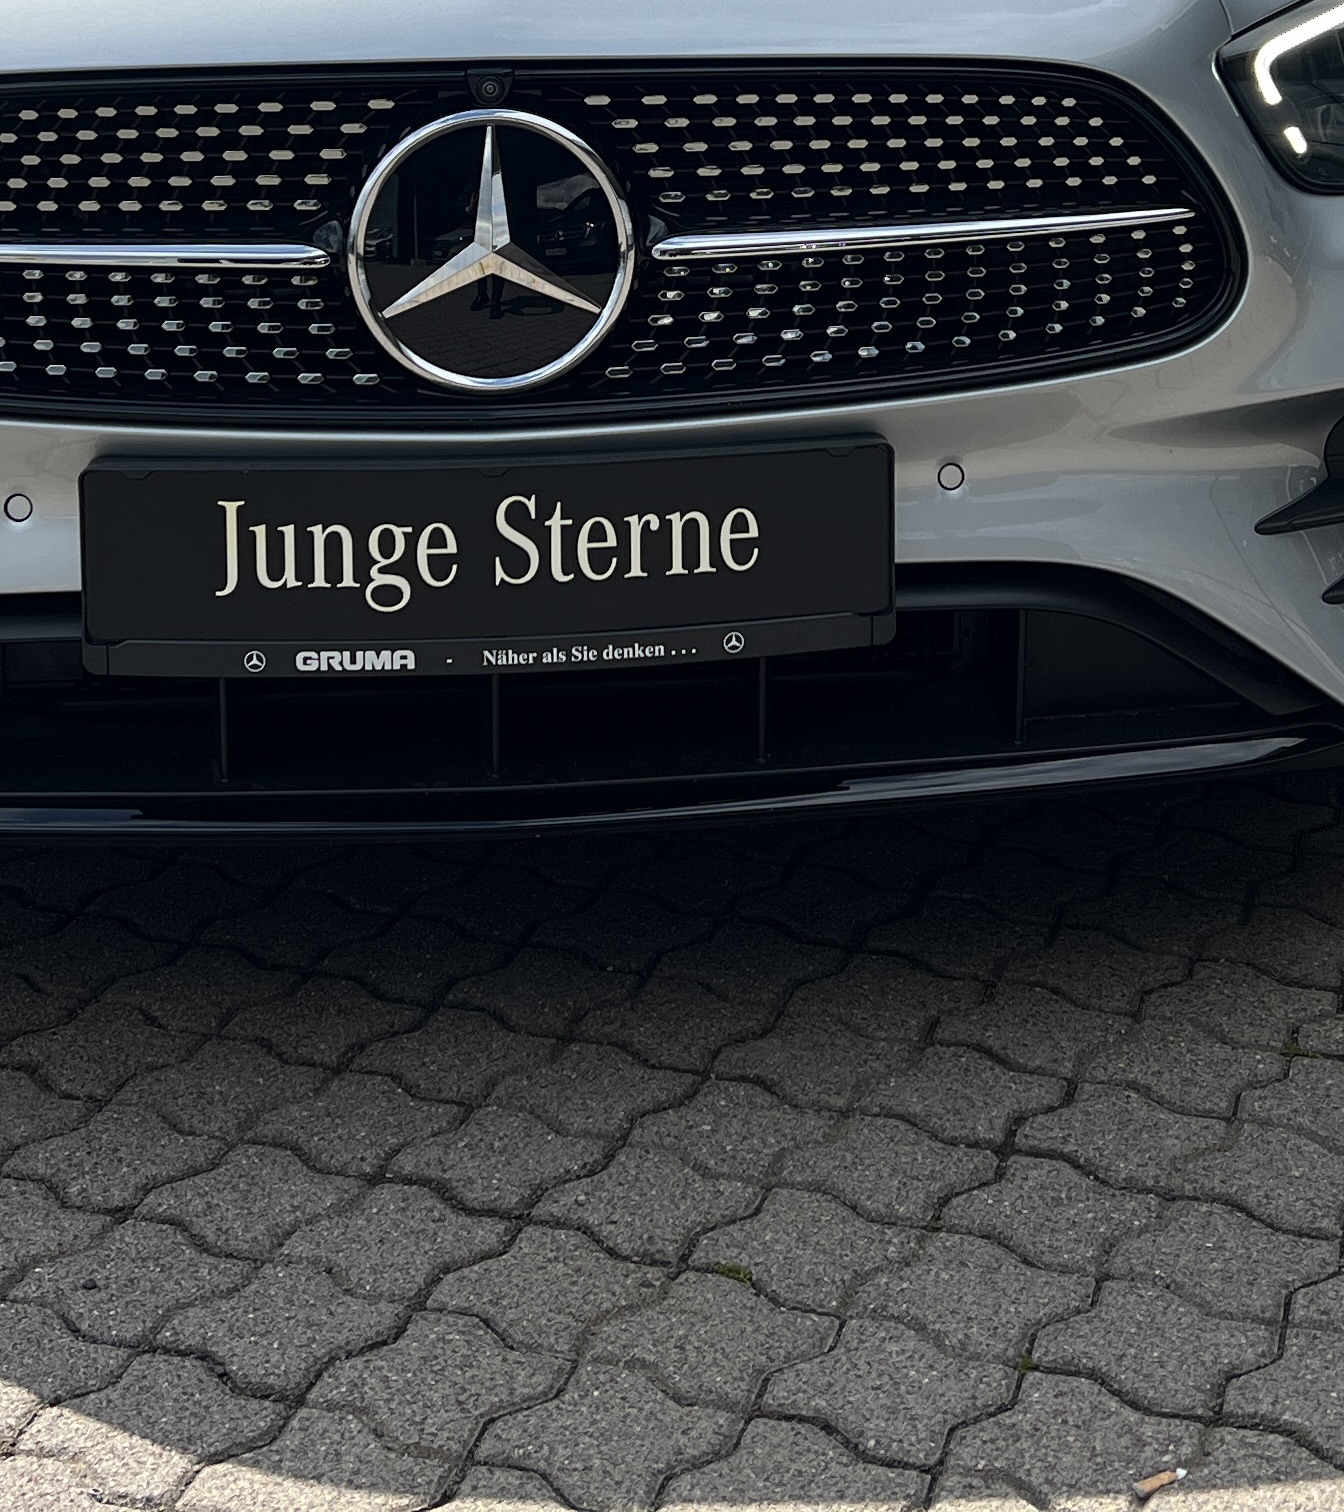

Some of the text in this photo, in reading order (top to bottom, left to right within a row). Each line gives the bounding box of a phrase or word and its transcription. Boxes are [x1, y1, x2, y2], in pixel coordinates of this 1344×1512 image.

[214, 494, 760, 613] Junge Sterne
[295, 649, 416, 672] GRUMA
[482, 649, 538, 666] Näher
[542, 647, 567, 664] als
[571, 645, 598, 662] Sie
[602, 642, 665, 661] denken
